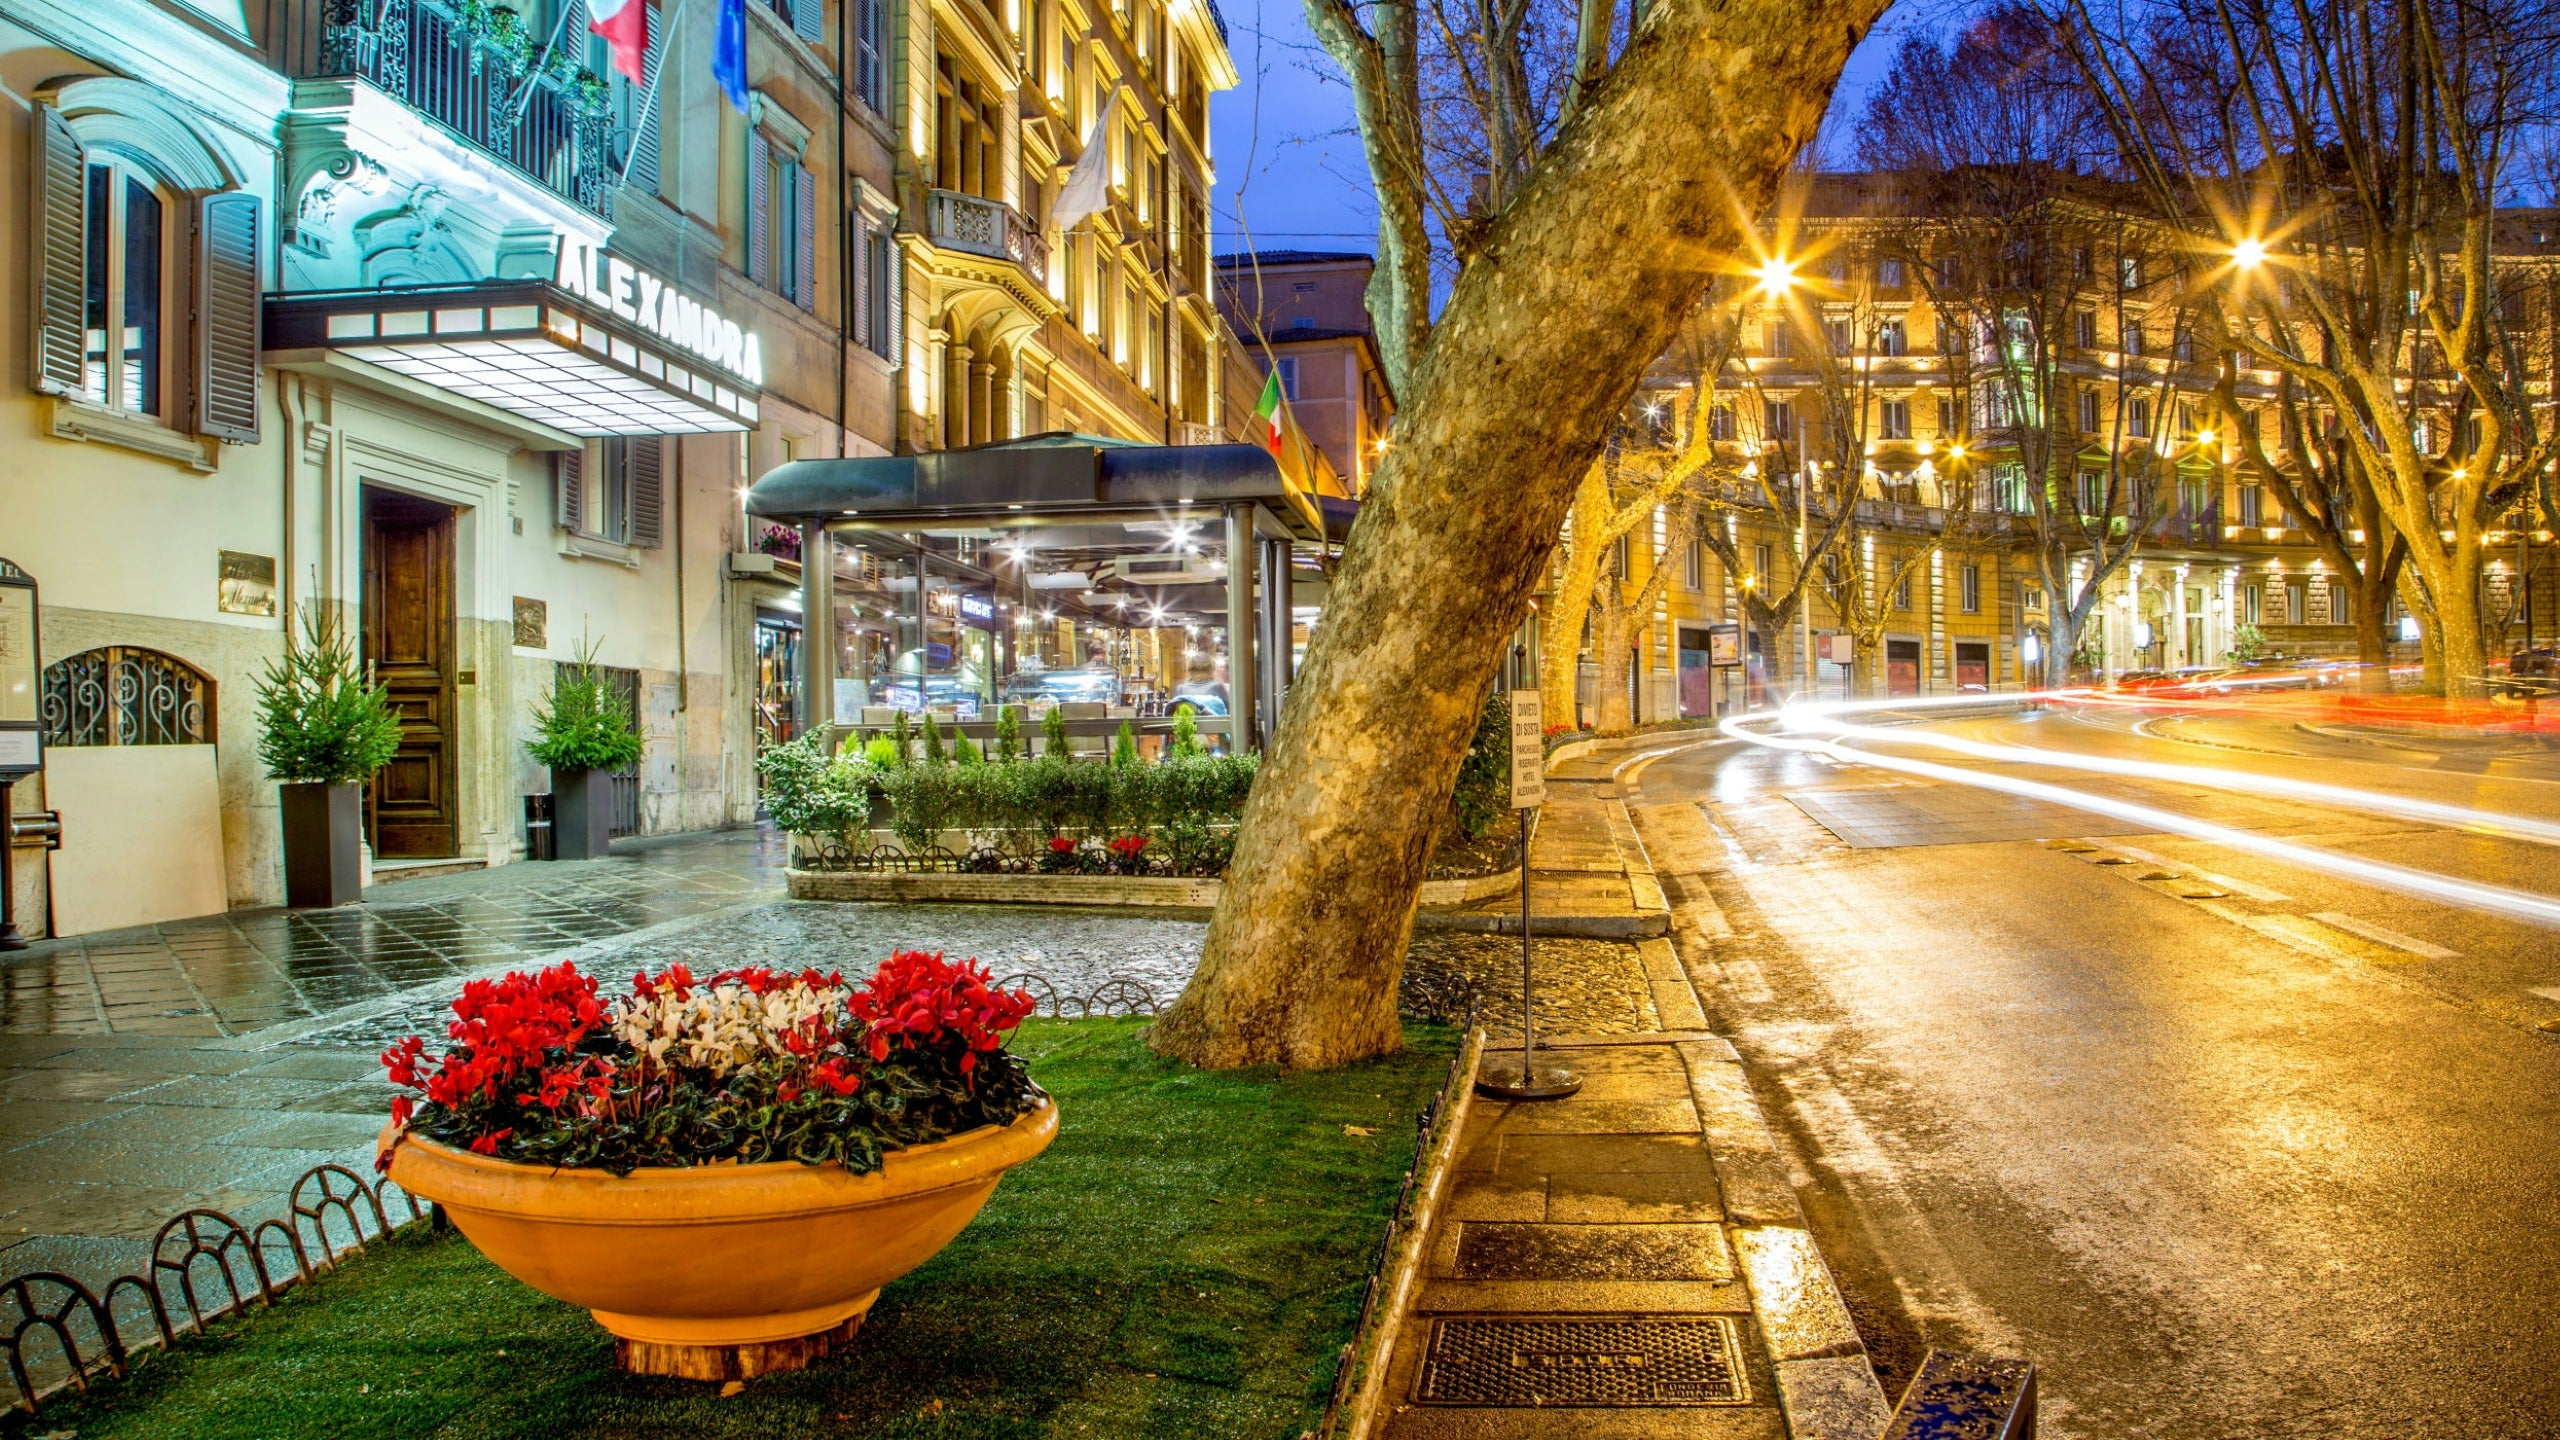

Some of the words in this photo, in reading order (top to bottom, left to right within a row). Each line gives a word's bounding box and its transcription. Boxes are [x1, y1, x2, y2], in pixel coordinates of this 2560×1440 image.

[556, 234, 763, 386] ALEXANDRA
[1518, 703, 1538, 717] DIVIETO
[1516, 724, 1523, 736] DI
[1523, 723, 1539, 736] SOSTA
[1522, 771, 1535, 782] HOTEL
